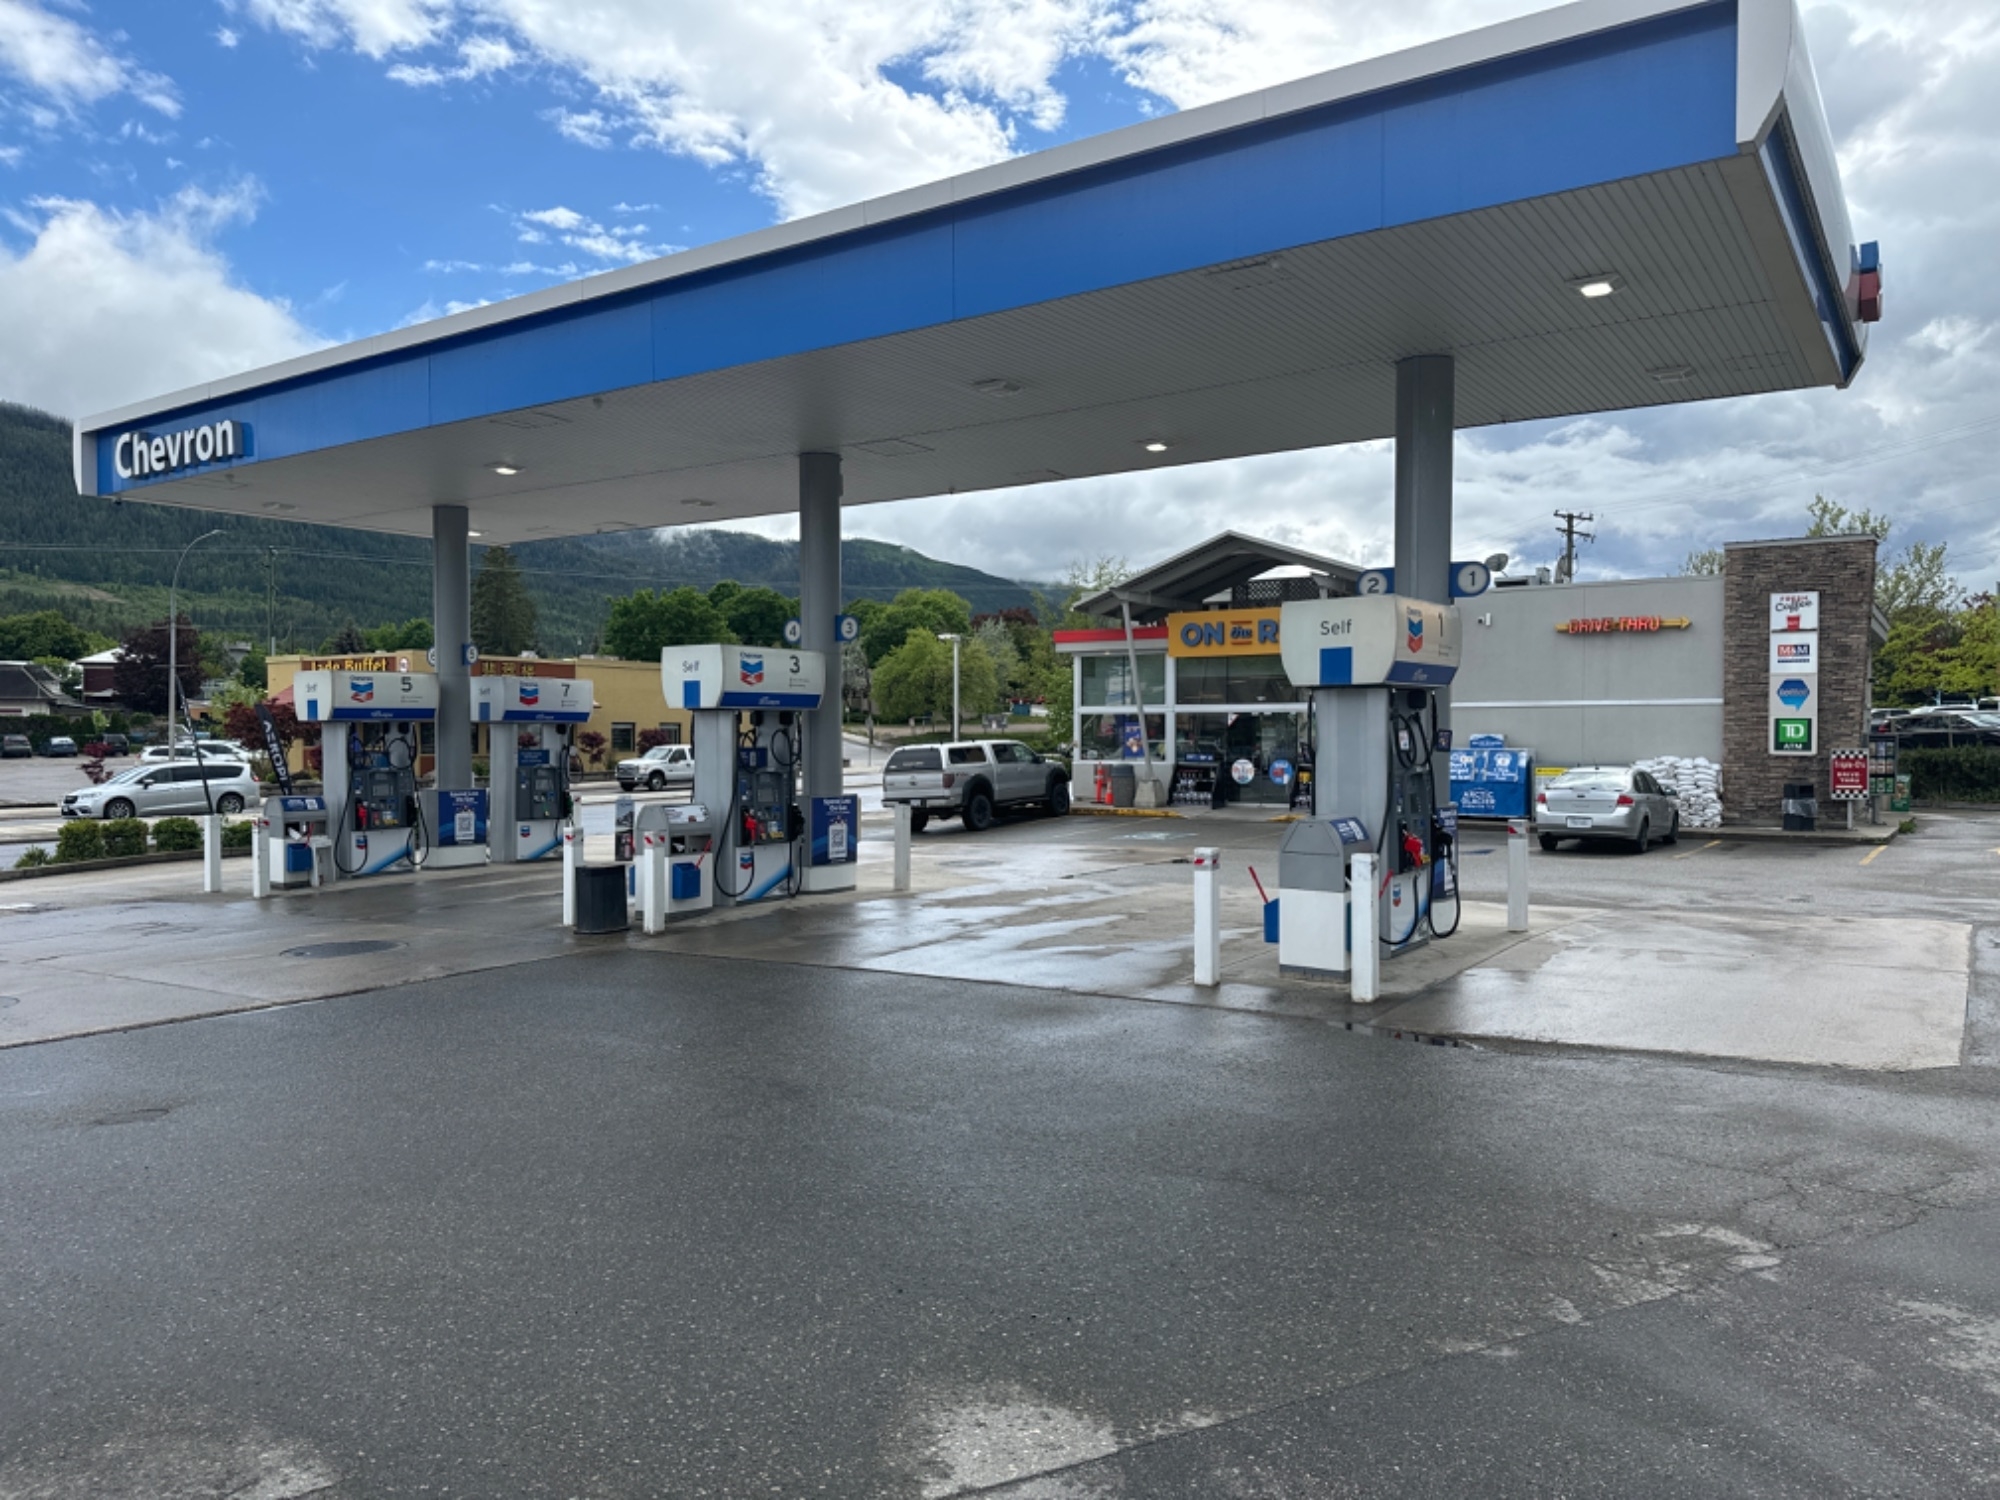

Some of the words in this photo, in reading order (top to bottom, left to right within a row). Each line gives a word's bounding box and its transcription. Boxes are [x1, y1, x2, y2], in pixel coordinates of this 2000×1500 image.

[115, 420, 234, 478] Chevron
[1366, 577, 1380, 594] 2
[1468, 570, 1476, 587] 1
[1775, 600, 1813, 613] Coffee
[789, 624, 797, 637] 4
[846, 620, 853, 634] 3
[1320, 619, 1352, 636] Self
[1438, 611, 1444, 638] 1
[1568, 618, 1612, 634] DRIVE
[1618, 616, 1661, 632] THRU
[1181, 621, 1224, 647] ON
[1230, 625, 1252, 638] the
[1258, 619, 1279, 643] R
[344, 656, 388, 671] Buffet
[682, 661, 700, 673] Self
[789, 655, 800, 673] 3
[401, 676, 413, 692] 5
[561, 683, 570, 697] 7
[1781, 723, 1804, 738] TD
